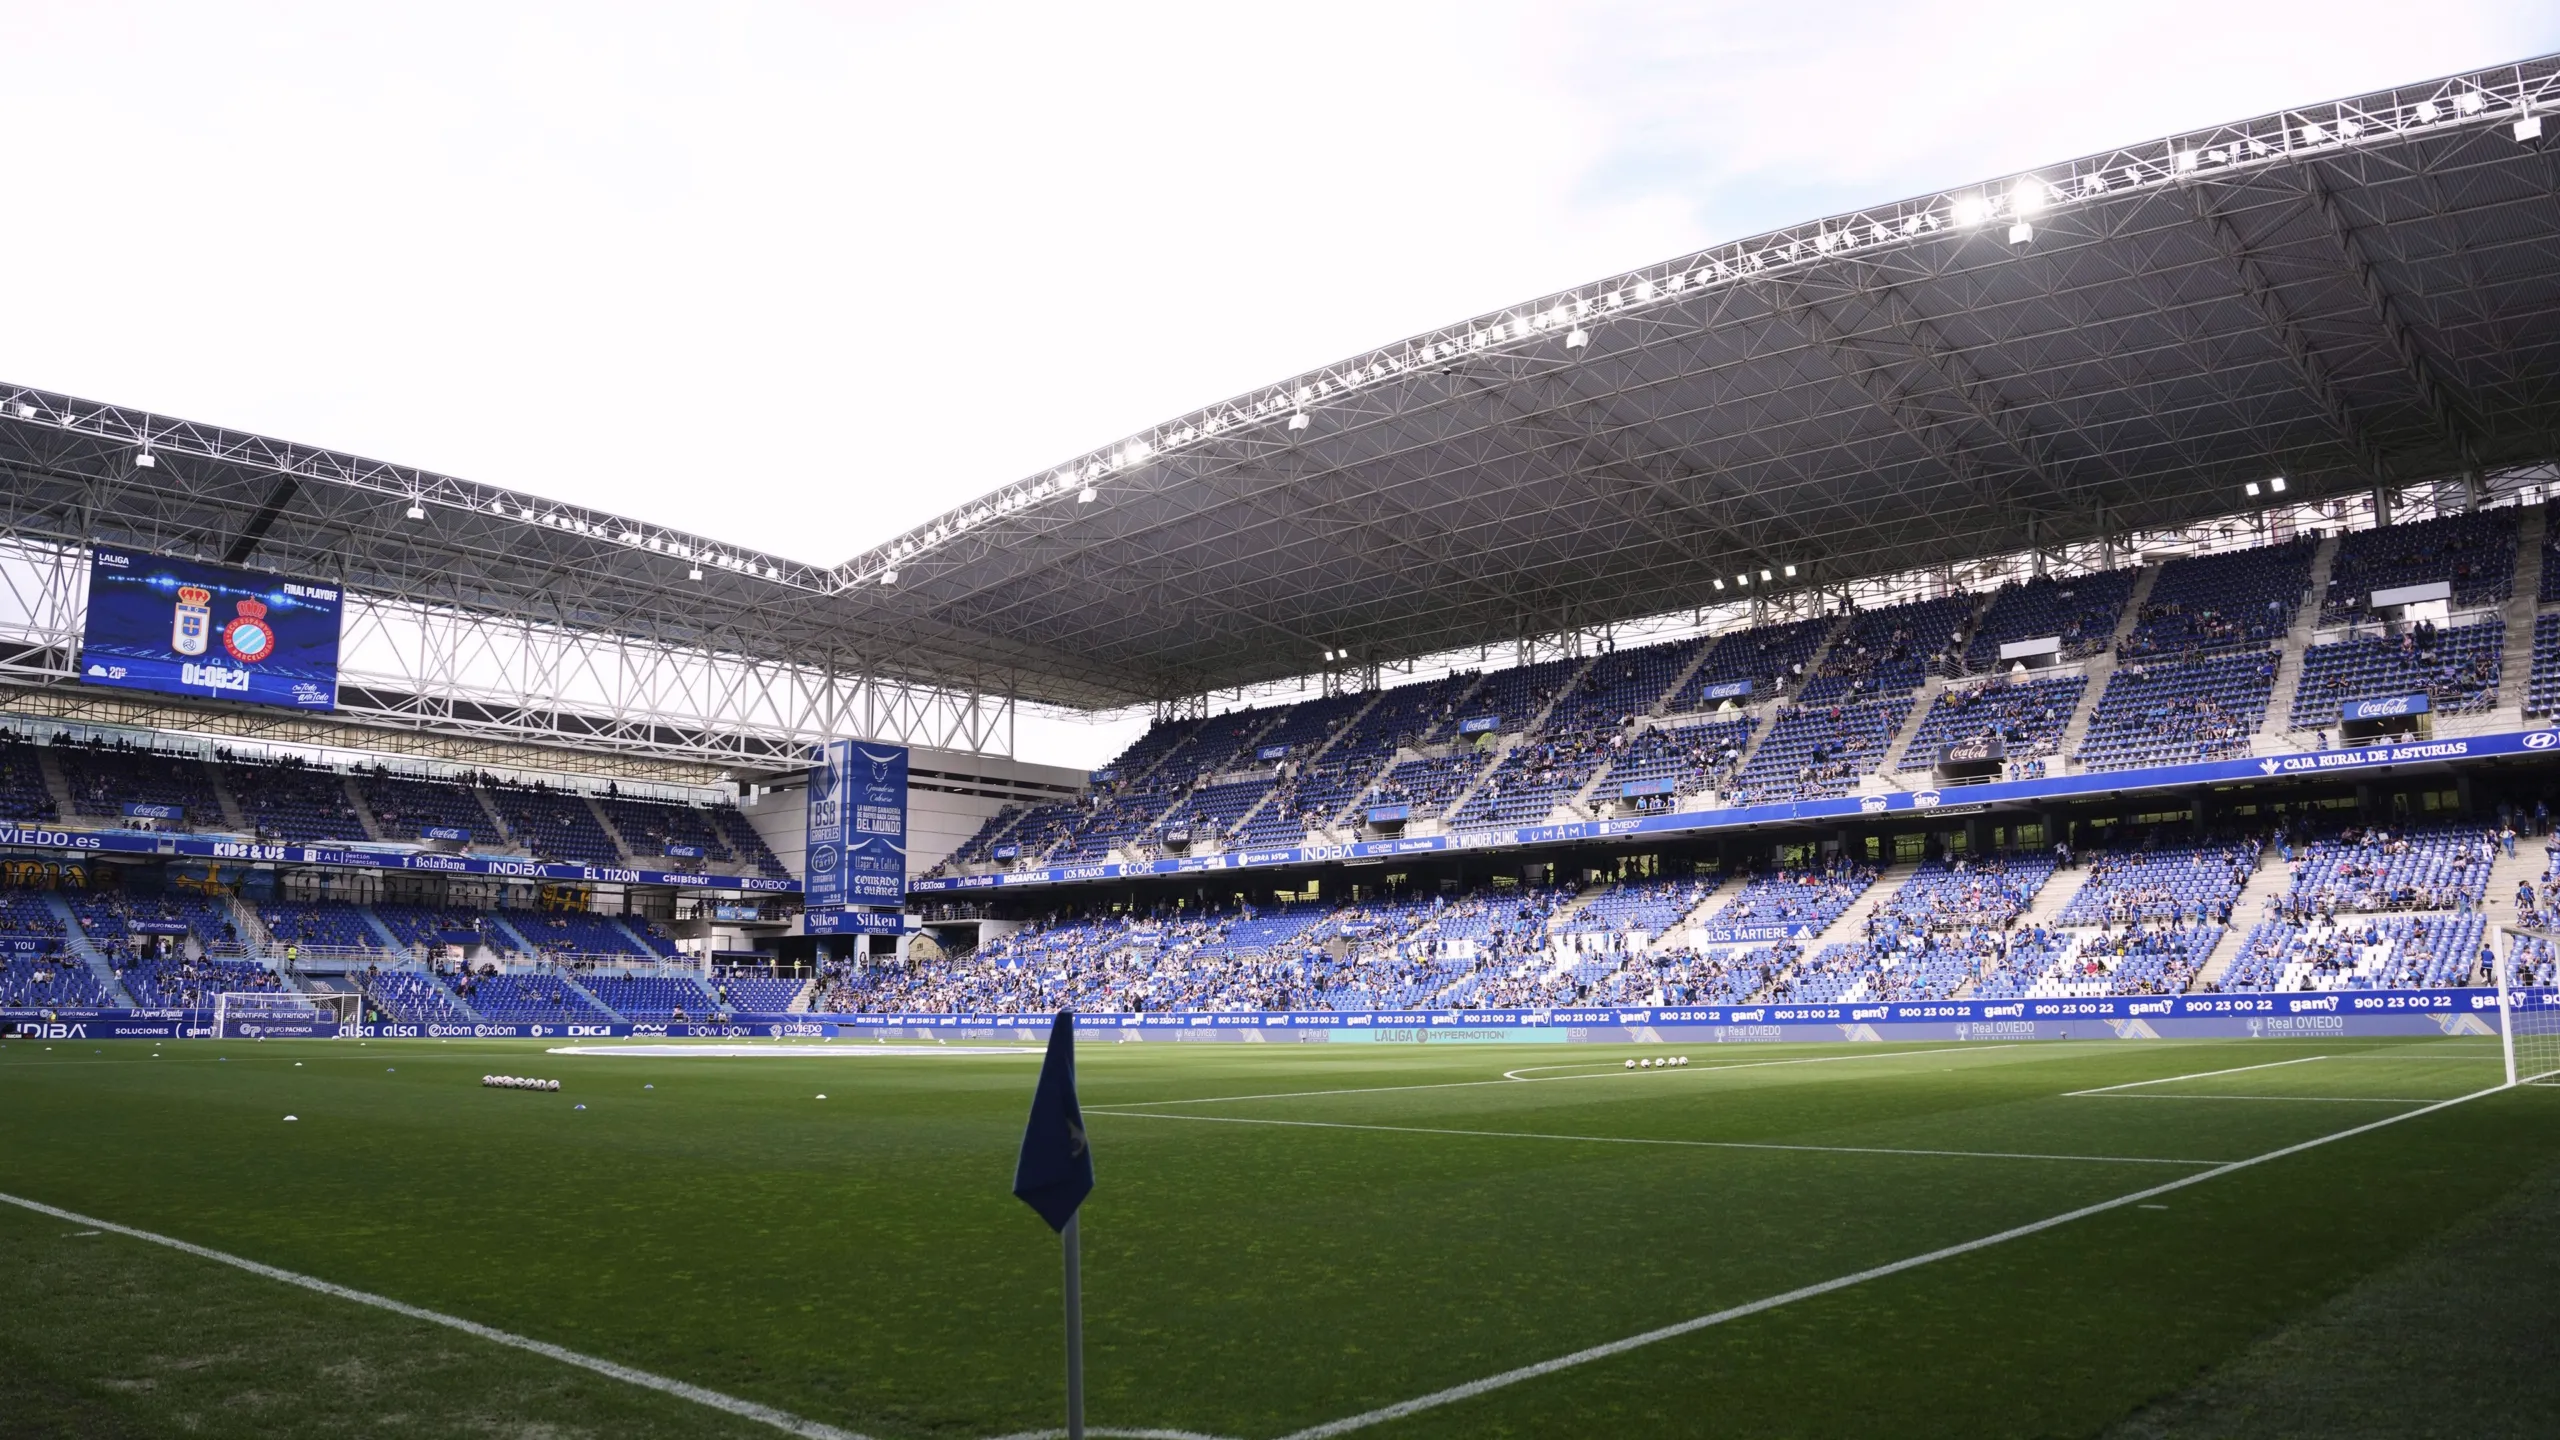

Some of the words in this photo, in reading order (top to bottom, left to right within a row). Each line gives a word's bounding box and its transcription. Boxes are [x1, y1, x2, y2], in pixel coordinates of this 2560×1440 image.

[99, 553, 129, 565] LALIGA
[283, 583, 304, 597] FINAL
[306, 587, 338, 601] PLAYOFF
[182, 663, 249, 692] 01:05:21
[2284, 757, 2316, 770] CAJA
[2319, 752, 2366, 767] RURAL
[2368, 750, 2388, 762] DE
[2391, 742, 2468, 760] ASTURIAS
[816, 800, 835, 826] BSB
[857, 818, 870, 830] DEL
[872, 820, 900, 832] MUNDO
[1610, 820, 1640, 830] OVIEDO
[1445, 836, 1459, 849] THE
[1460, 833, 1493, 848] WONDER
[1494, 830, 1518, 846] CLINIC
[214, 843, 248, 857] KIDS
[251, 844, 262, 859] &
[264, 846, 285, 860] US
[1302, 846, 1353, 860] INDIBA
[489, 862, 547, 876] INDIBA
[1064, 870, 1076, 880] LOS
[1078, 867, 1104, 878] PRADOS
[1129, 862, 1154, 875] COPE
[584, 868, 599, 880] EL
[603, 869, 640, 882] TIZON
[751, 879, 788, 890] OVIEDO
[810, 914, 838, 926] Silken
[856, 913, 896, 927] Silken
[14, 942, 36, 950] YOU
[2186, 1000, 2212, 1012] 900
[2216, 1000, 2232, 1012] 23
[2234, 1000, 2254, 1012] 00
[2256, 1000, 2273, 1012] 22
[2354, 996, 2384, 1008] 900
[2387, 996, 2405, 1008] 23
[2408, 996, 2430, 1008] 00
[2433, 996, 2452, 1008] 22
[130, 1009, 139, 1017] La
[1774, 1010, 1795, 1019] 900
[1797, 1010, 1809, 1019] 23
[1811, 1010, 1826, 1019] 00
[1828, 1010, 1840, 1019] 22
[1900, 1006, 1921, 1016] 900
[1924, 1006, 1937, 1016] 23
[1940, 1006, 1955, 1016] 00
[1957, 1006, 1970, 1016] 22
[2036, 1004, 2060, 1014] 900
[2062, 1004, 2076, 1014] 23
[2080, 1004, 2096, 1014] 00
[2099, 1004, 2114, 1014] 22
[1554, 1014, 1571, 1022] 900
[1572, 1014, 1583, 1022] 23
[1585, 1014, 1597, 1022] 00
[1598, 1014, 1610, 1022] 22
[1660, 1012, 1678, 1020] 900
[1680, 1012, 1692, 1020] 23
[1694, 1012, 1707, 1020] 00
[1708, 1012, 1720, 1020] 22
[784, 1024, 822, 1032] OVIEDO
[1972, 1022, 1994, 1034] Real
[1996, 1022, 2034, 1033] OVIEDO
[2268, 1018, 2292, 1029] Real
[2296, 1016, 2342, 1029] OVIEDO
[338, 1026, 374, 1037] alsa
[382, 1025, 418, 1037] alsa
[545, 1026, 554, 1036] bp
[568, 1026, 611, 1036] DIGI
[1375, 1030, 1413, 1042] LALIGA
[1430, 1030, 1504, 1040] HYPERMOTION
[1728, 1026, 1746, 1036] Real
[1748, 1025, 1780, 1036] OVIEDO
